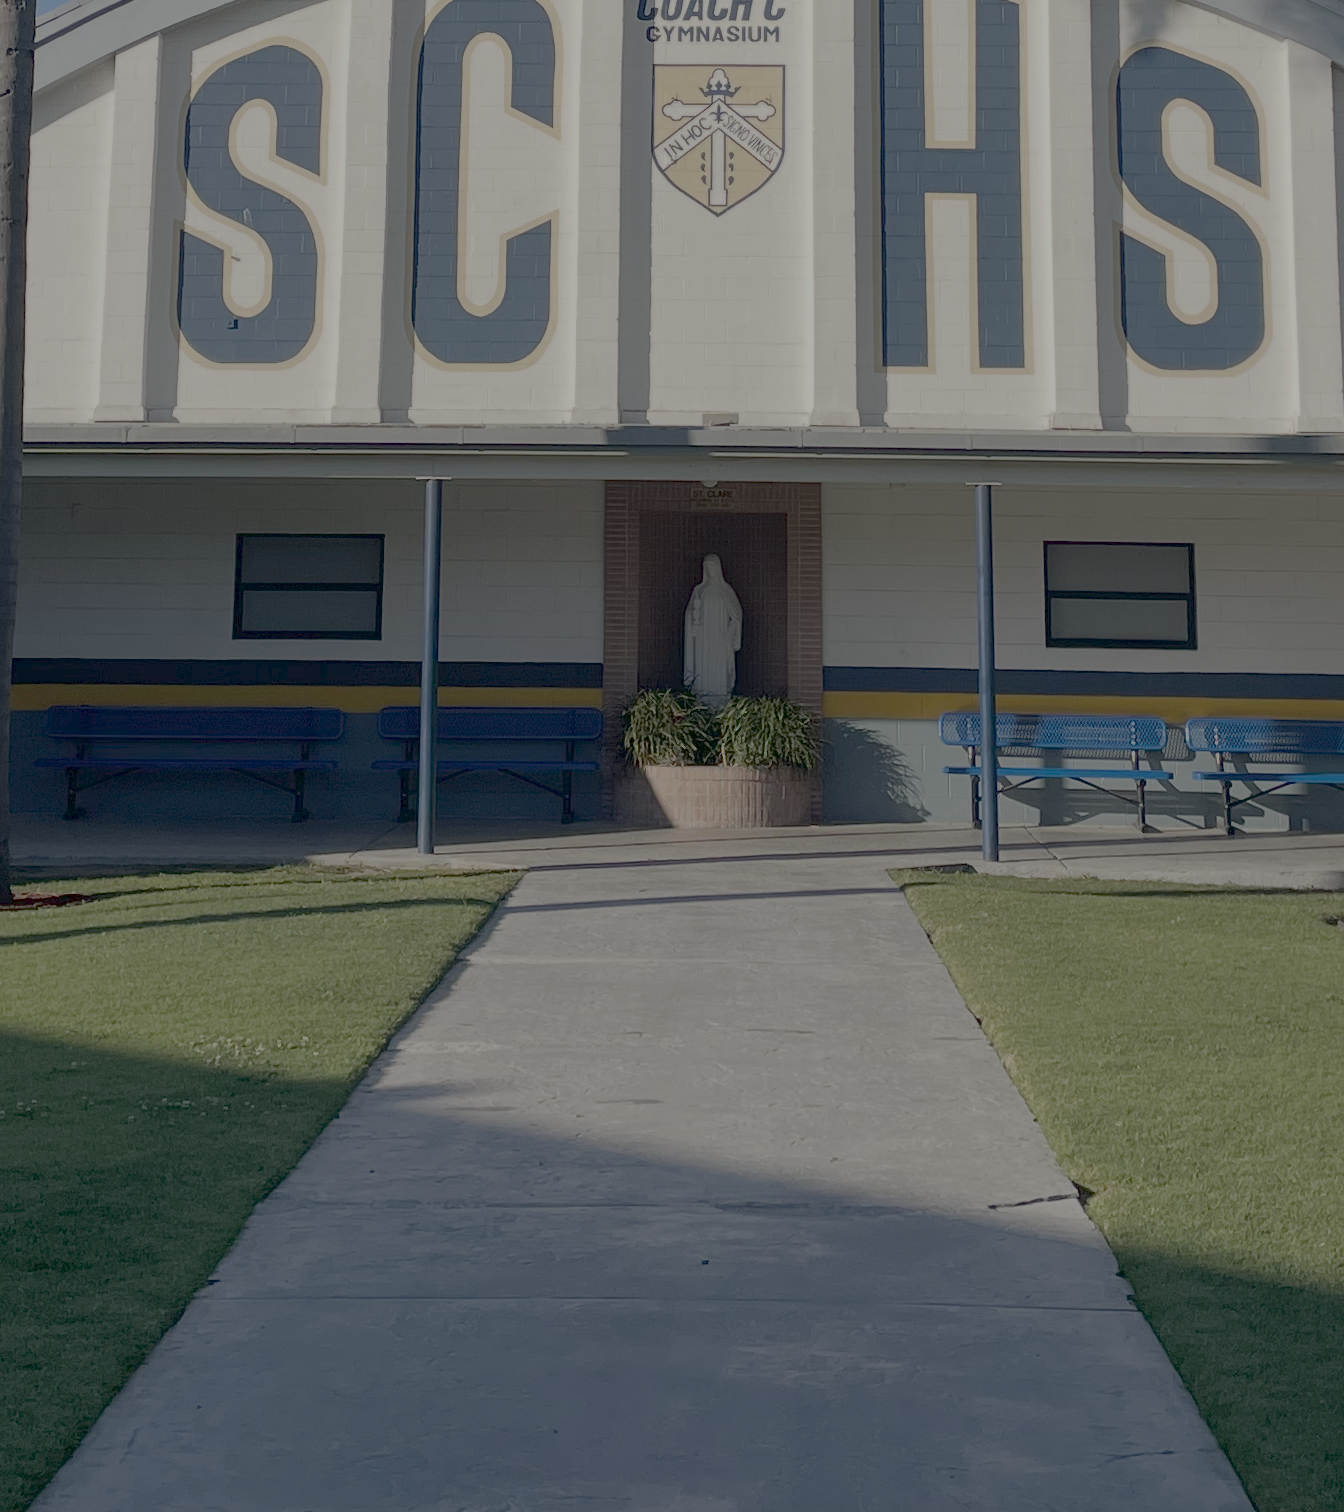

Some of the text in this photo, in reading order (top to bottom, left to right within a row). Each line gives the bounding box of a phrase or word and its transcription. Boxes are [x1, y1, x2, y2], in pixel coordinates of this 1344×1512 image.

[646, 25, 780, 43] GYMNASIUM
[664, 115, 779, 164] IN HOC SIGNO VINCES
